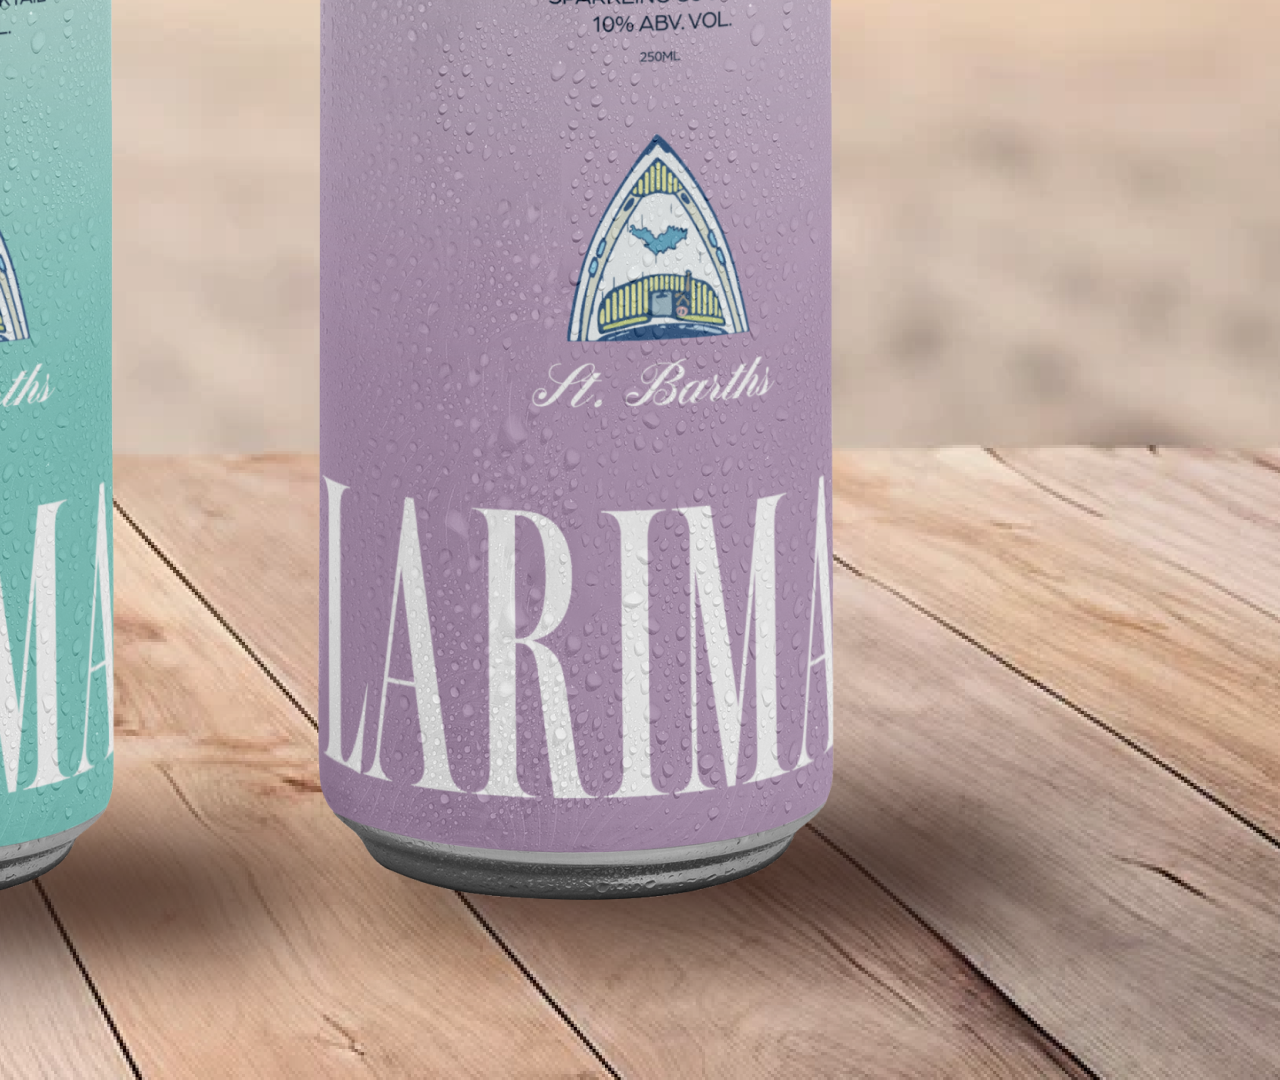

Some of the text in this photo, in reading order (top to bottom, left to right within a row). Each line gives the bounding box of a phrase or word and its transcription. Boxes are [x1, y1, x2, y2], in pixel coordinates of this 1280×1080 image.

[593, 11, 732, 34] 10% ABV. VOL.
[640, 50, 681, 63] 250ML
[532, 356, 775, 408] St. Barths
[322, 474, 834, 800] LARIMA
